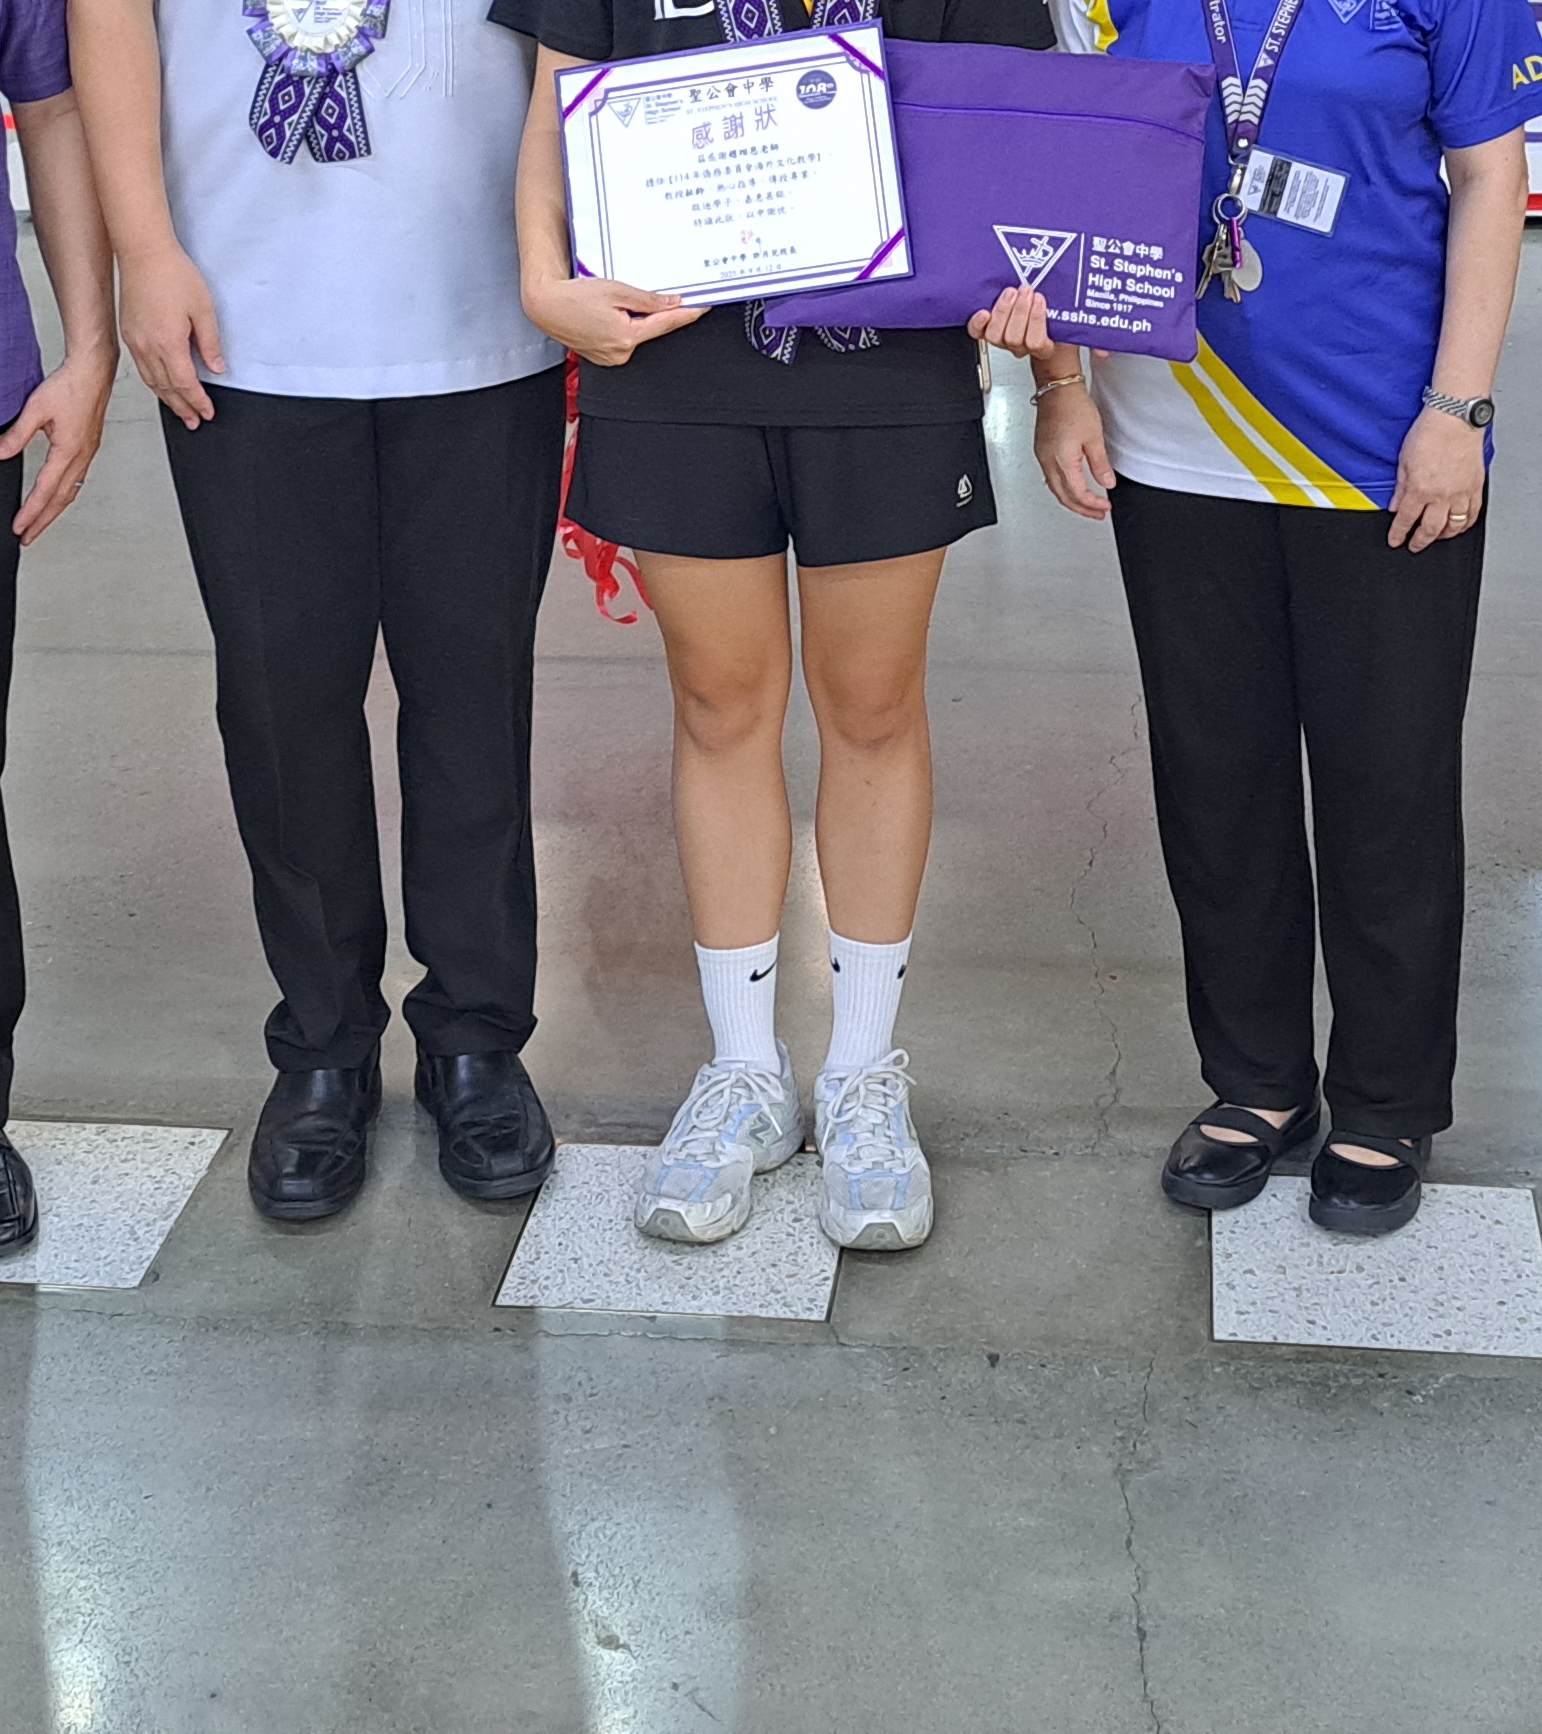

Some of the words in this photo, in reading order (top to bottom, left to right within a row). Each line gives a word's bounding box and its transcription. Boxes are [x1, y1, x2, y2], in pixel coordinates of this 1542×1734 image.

[692, 104, 778, 149] 感謝狀
[1092, 237, 1163, 260] 聖公會中學
[1090, 255, 1109, 270] St.
[1113, 259, 1183, 282] Stephen's
[1086, 288, 1118, 302] Manila,
[1119, 293, 1164, 308] Philippines
[1088, 273, 1122, 290] High
[1126, 278, 1175, 299] School
[1085, 298, 1110, 310] Since
[1112, 301, 1133, 313] 1917
